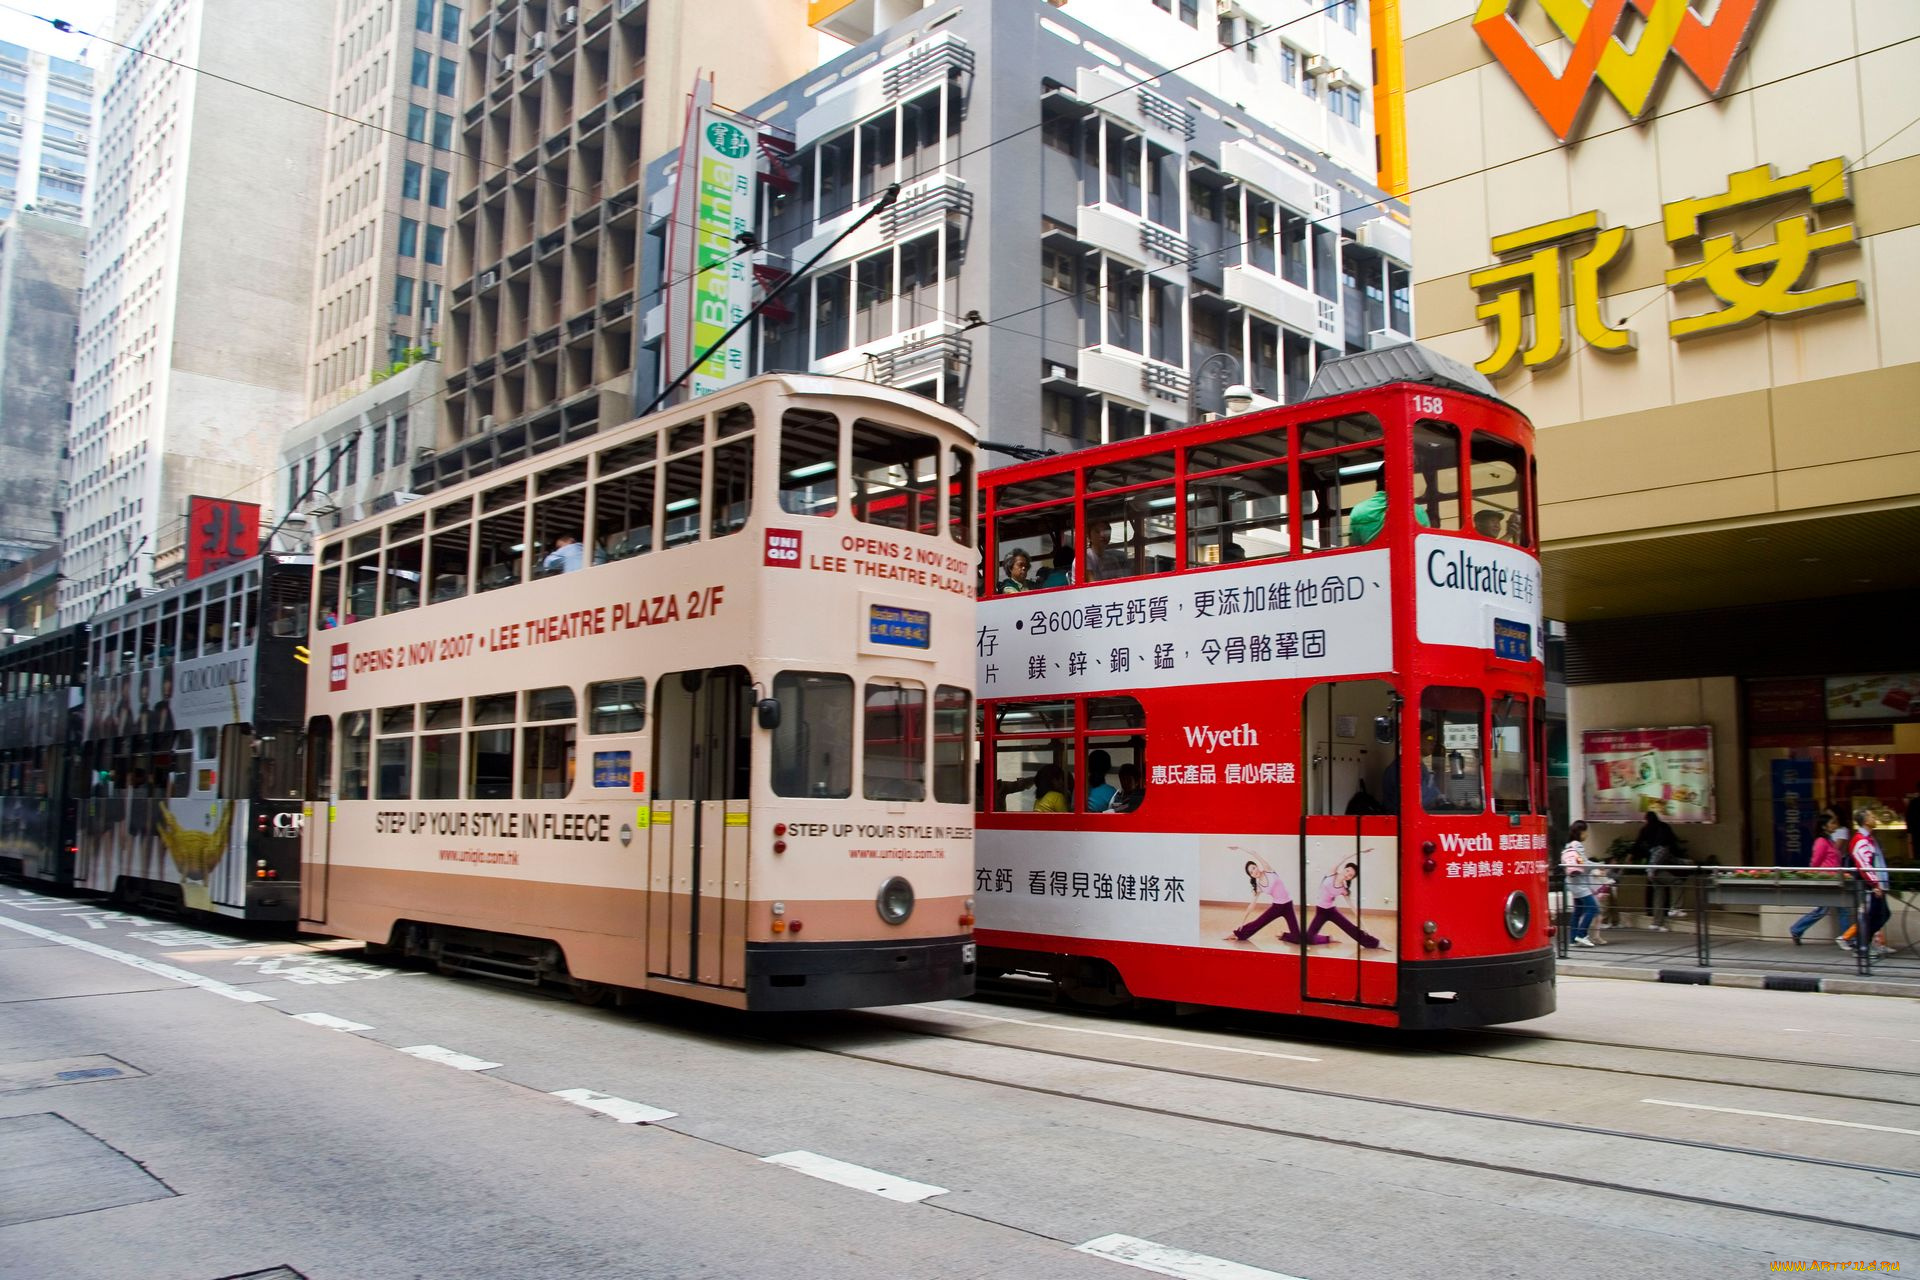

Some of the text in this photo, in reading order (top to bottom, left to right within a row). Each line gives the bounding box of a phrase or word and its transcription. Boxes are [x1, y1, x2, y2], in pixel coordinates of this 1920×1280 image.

[1470, 156, 1864, 377] 永安
[1413, 395, 1443, 414] 158
[768, 549, 798, 560] QLO
[769, 536, 798, 549] UNI
[841, 535, 899, 559] OPENS
[904, 547, 912, 560] 2
[917, 548, 943, 567] NOV
[810, 554, 847, 573] LEE
[854, 559, 926, 586] THEATRE
[931, 573, 964, 596] PLAZA
[1428, 548, 1507, 596] Caltrate
[354, 585, 725, 675] OPENS 2 NOV 2007 LEE THEATRE PLAZA 2/F
[976, 625, 1000, 658] 存
[986, 664, 1000, 684] 片
[1183, 722, 1259, 754] Wyeth
[1151, 762, 1296, 785] 惠氏產品 信心保證
[376, 811, 406, 834] STEP
[410, 811, 426, 834] UP
[429, 812, 468, 836] YOUR
[472, 812, 518, 838] STYLE
[522, 813, 538, 839] IN
[542, 813, 610, 842] FLEECE
[788, 823, 829, 838] STEP
[833, 824, 853, 838] UP
[857, 825, 895, 838] YOUR
[898, 826, 932, 839] STYLE
[935, 826, 945, 839] IN
[849, 848, 945, 861] www.uniqlo.com.hk
[1438, 833, 1493, 857] Wyeth
[976, 867, 1185, 903] 充鈣 看得見強健將來
